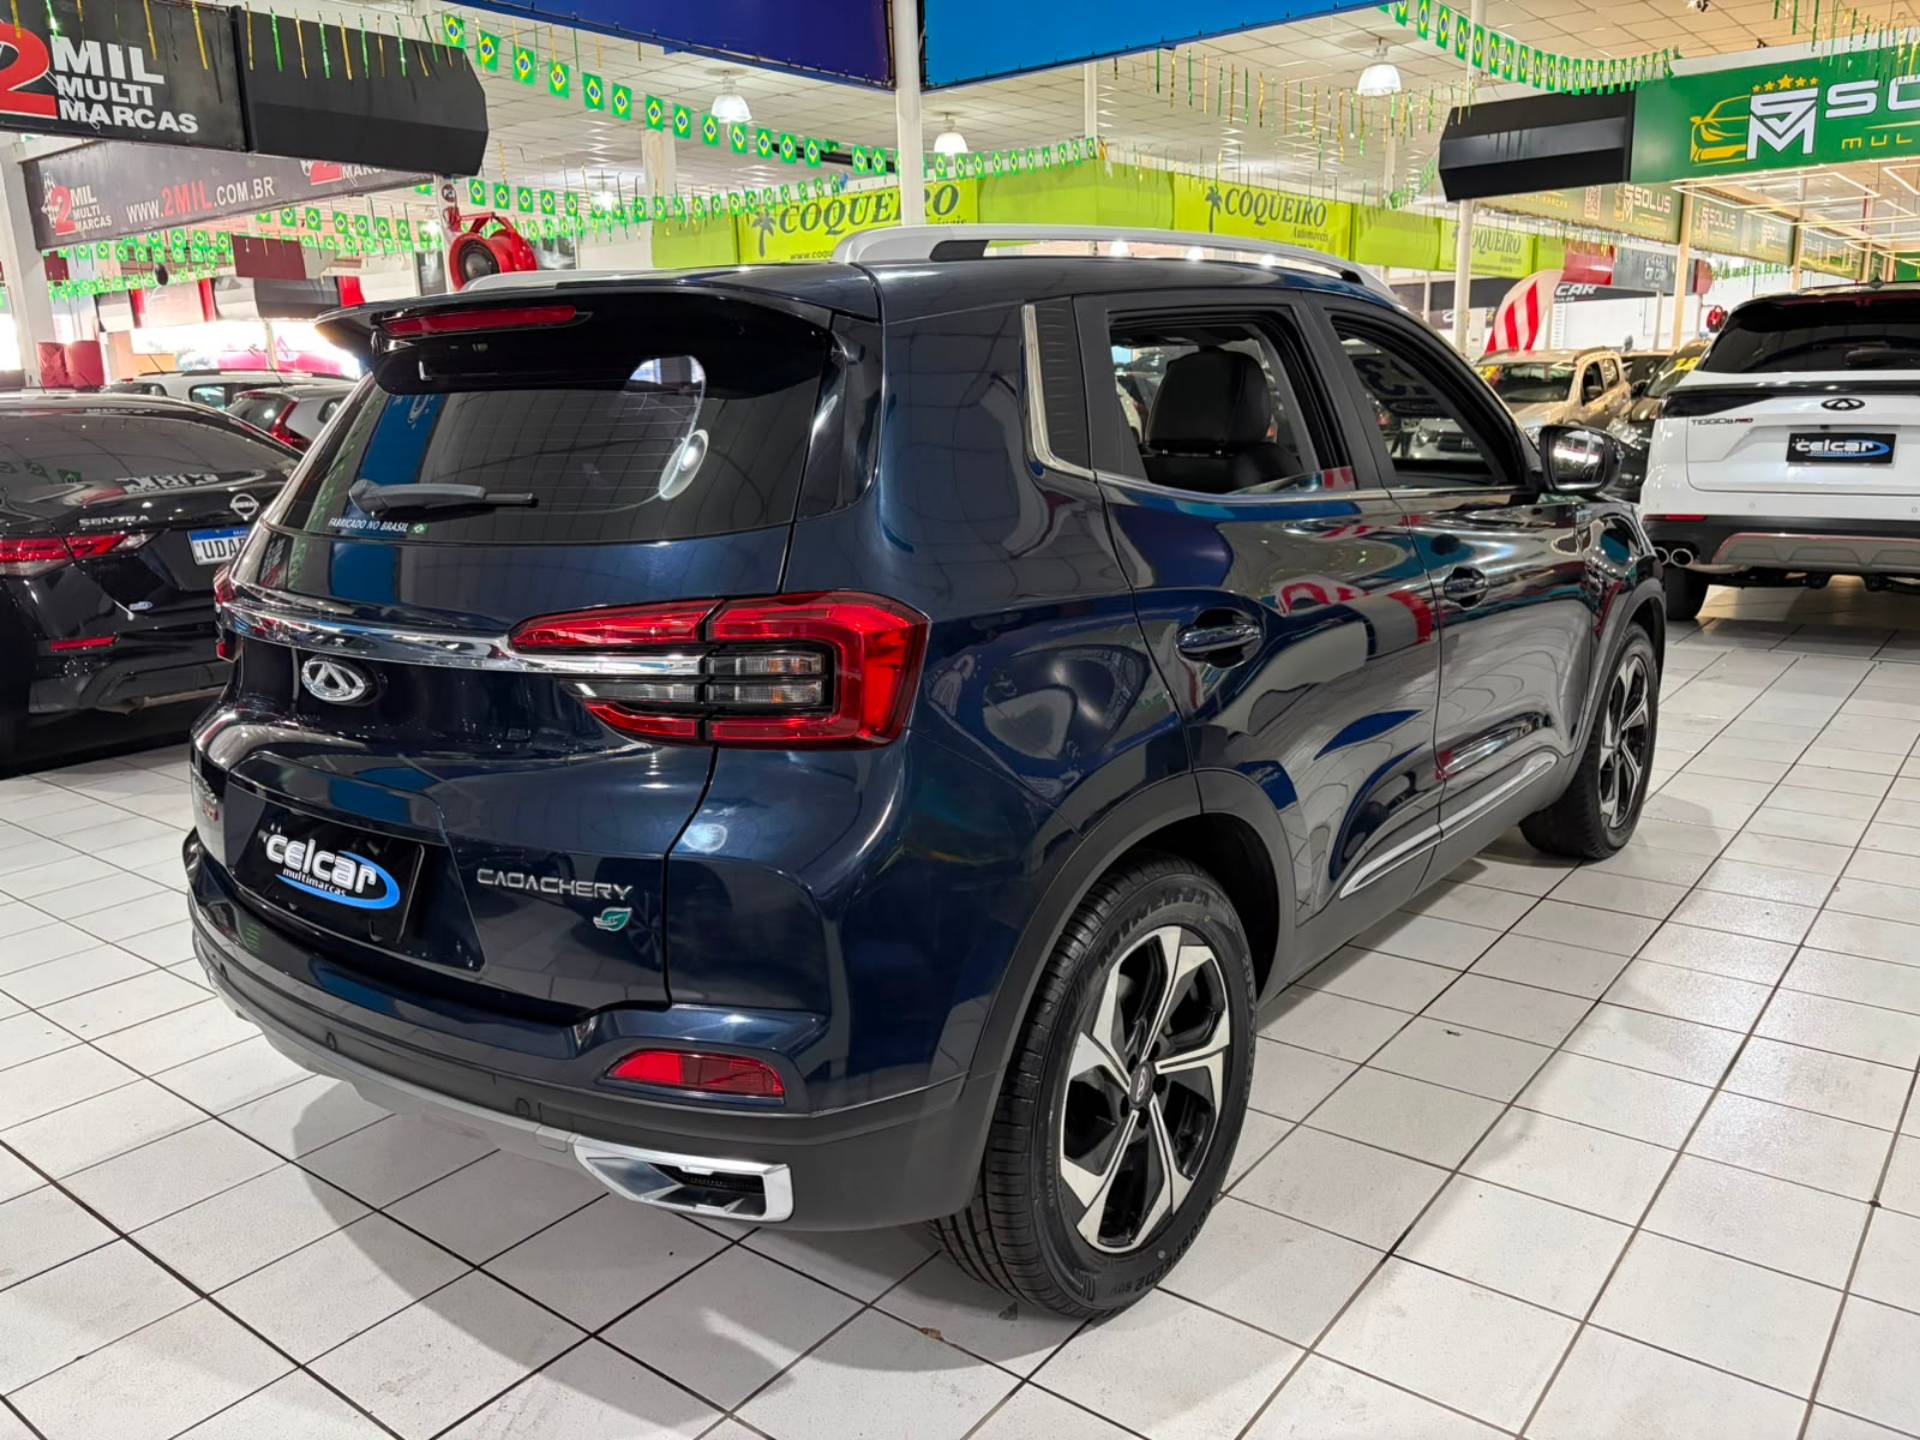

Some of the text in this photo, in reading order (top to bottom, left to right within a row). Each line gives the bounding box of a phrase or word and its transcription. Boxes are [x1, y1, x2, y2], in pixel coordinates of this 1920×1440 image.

[50, 34, 165, 85] MIL
[56, 74, 154, 107] MULTI
[58, 99, 199, 134] MARCAS
[70, 184, 98, 204] MIL
[125, 175, 275, 225] WWW.2MIL.COM.BR
[1224, 186, 1327, 228] COQUEIRO
[1634, 186, 1671, 214] SOLUS
[71, 203, 101, 220] MULTI
[75, 213, 113, 230] MARCAS
[778, 183, 960, 236] COQUEO
[1472, 228, 1521, 255] OQUEIRO
[1795, 439, 1874, 453] celcar
[79, 514, 150, 528] SENTRA
[328, 518, 409, 533] FABRICADO NO BRASIL
[265, 833, 377, 894] celcar
[283, 866, 347, 898] multimarcas
